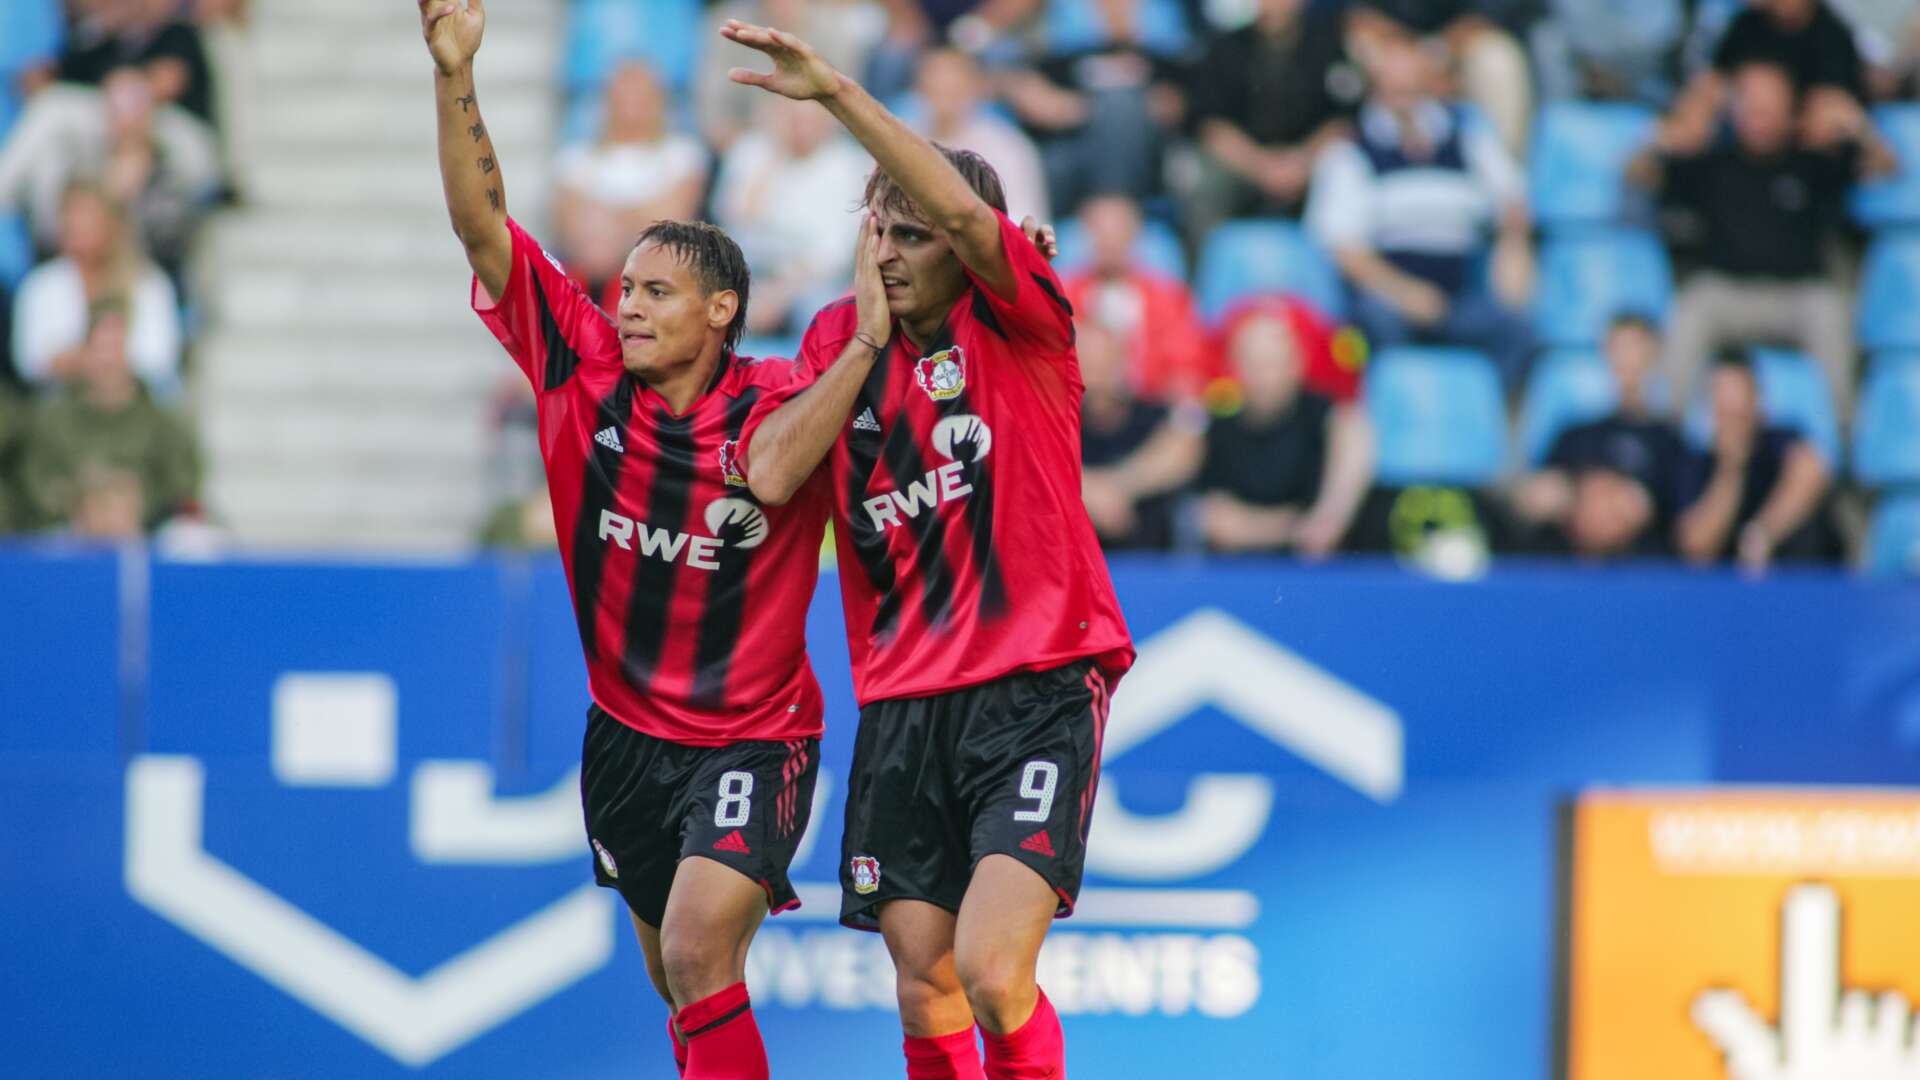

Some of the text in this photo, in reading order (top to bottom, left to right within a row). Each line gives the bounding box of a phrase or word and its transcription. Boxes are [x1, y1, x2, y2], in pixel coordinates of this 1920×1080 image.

[862, 460, 974, 532] RWE
[598, 508, 725, 571] RWE
[713, 771, 754, 827] 8
[1013, 760, 1059, 822] 9
